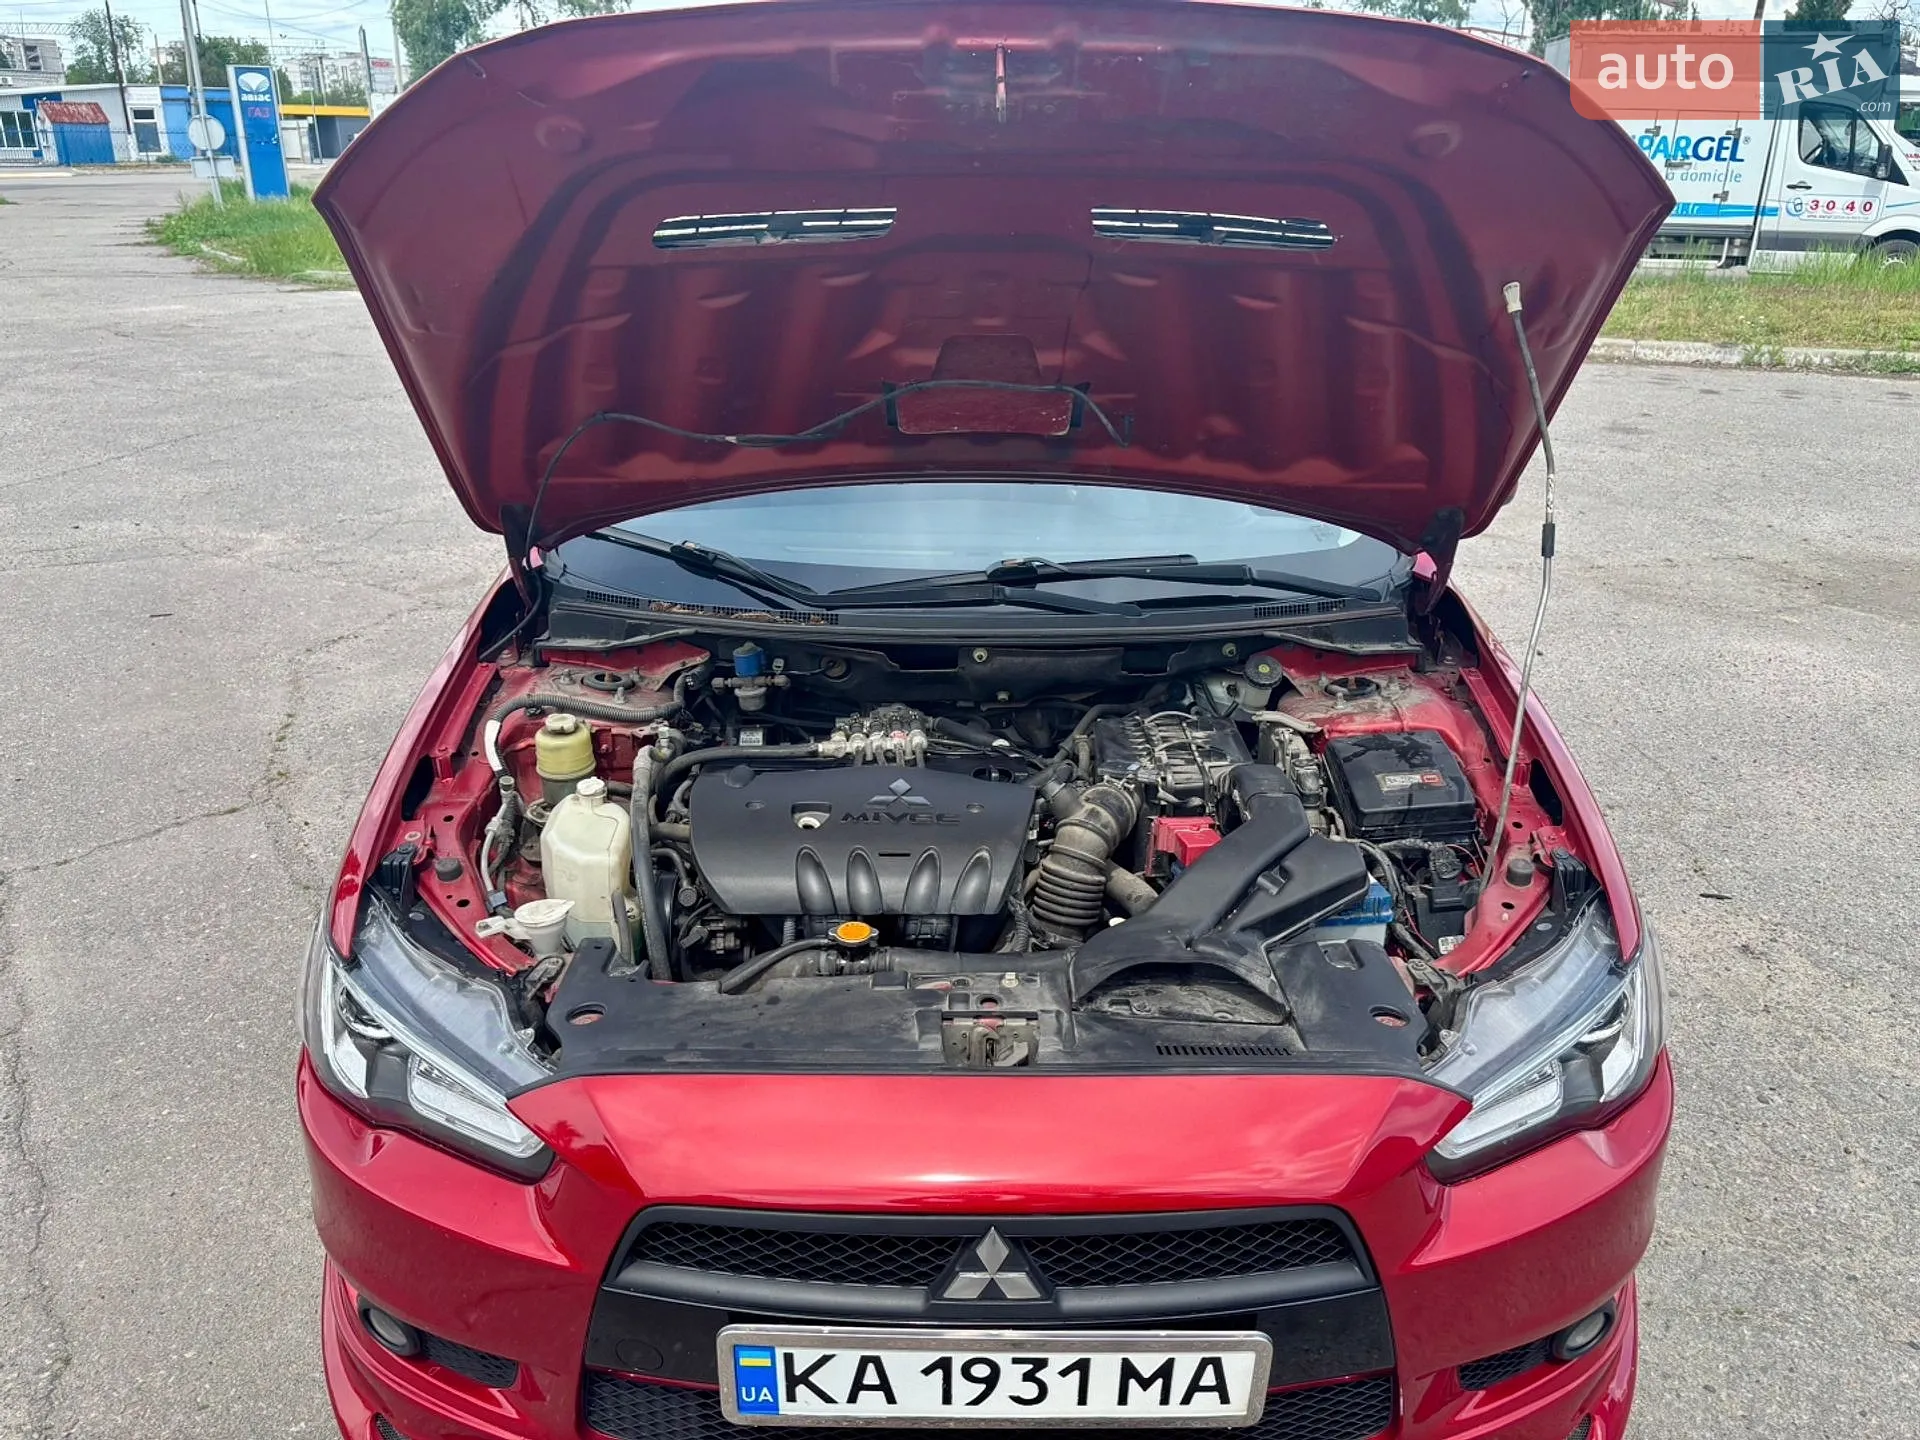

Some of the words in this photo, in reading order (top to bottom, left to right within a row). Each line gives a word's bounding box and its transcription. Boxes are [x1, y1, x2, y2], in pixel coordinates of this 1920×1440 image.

[1634, 135, 1745, 162] PARGEL
[784, 1352, 897, 1405] KA
[921, 1356, 1088, 1407] 1931
[1117, 1356, 1231, 1406] MA
[742, 1386, 773, 1403] UA
